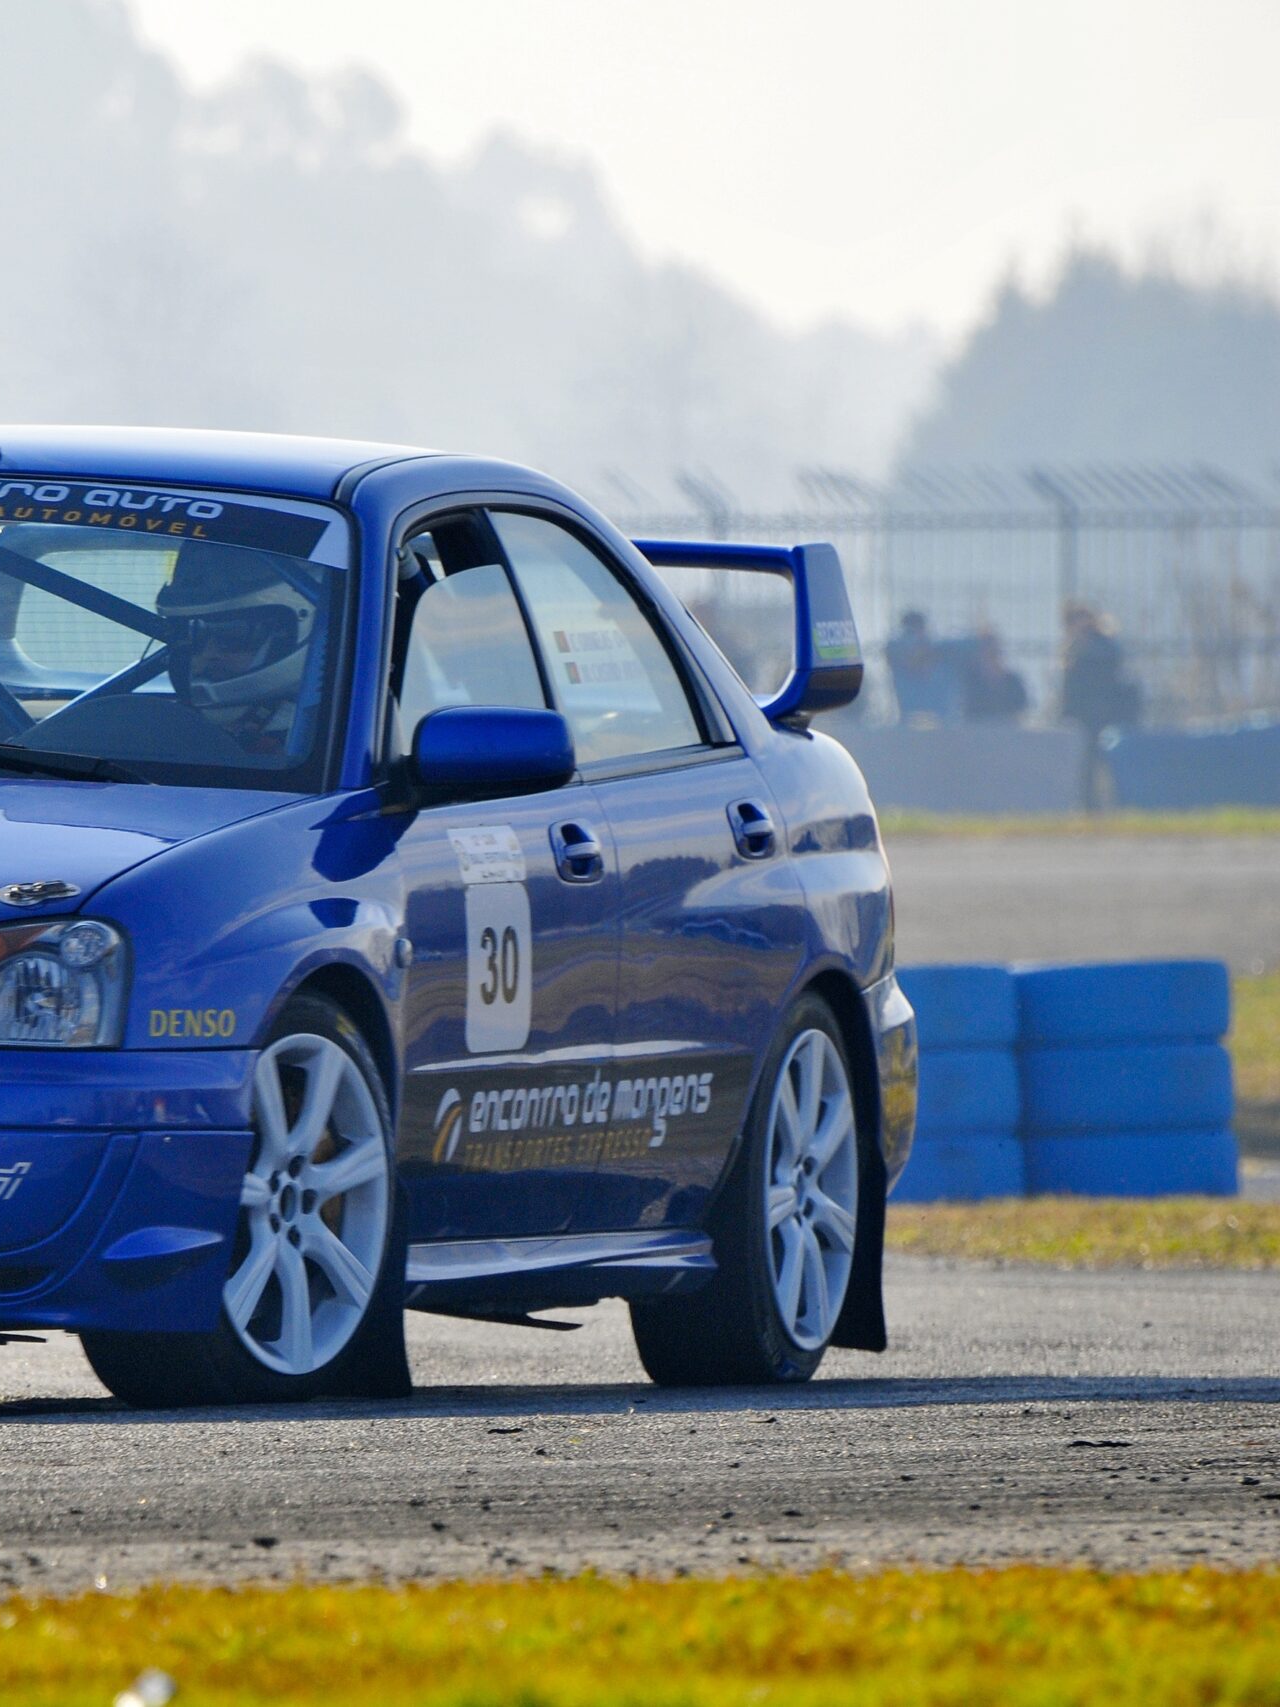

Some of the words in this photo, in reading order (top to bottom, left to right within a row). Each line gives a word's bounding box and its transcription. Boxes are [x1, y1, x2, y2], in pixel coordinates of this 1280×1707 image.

[480, 925, 518, 1006] 30
[149, 1009, 236, 1037] DENSO
[581, 1068, 613, 1125] de
